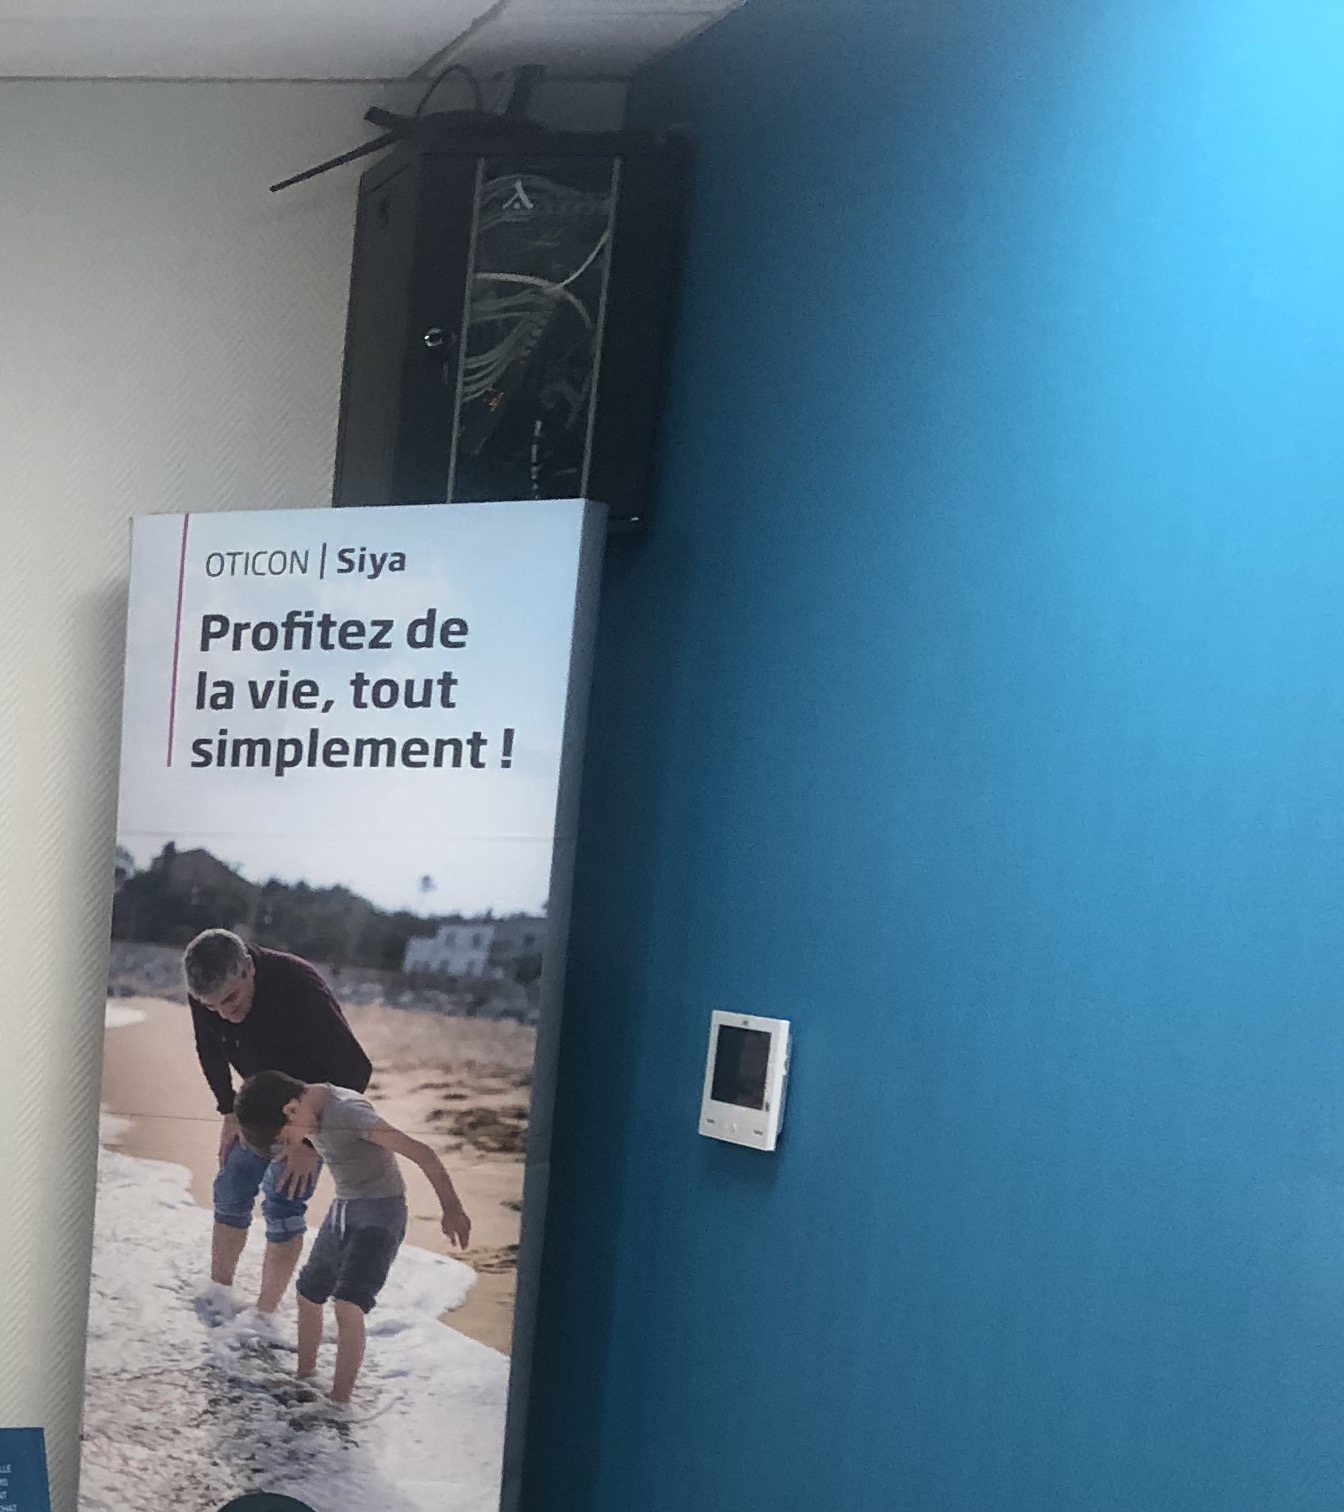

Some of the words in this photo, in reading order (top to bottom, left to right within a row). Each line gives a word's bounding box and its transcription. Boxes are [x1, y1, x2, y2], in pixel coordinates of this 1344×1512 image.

[205, 549, 310, 578] OTICON
[336, 546, 407, 579] Siya
[200, 609, 393, 652] Profitez
[407, 608, 469, 650] de
[195, 670, 235, 711] la
[248, 669, 335, 713] vie,
[350, 670, 459, 710] tout
[190, 728, 488, 777] simplement
